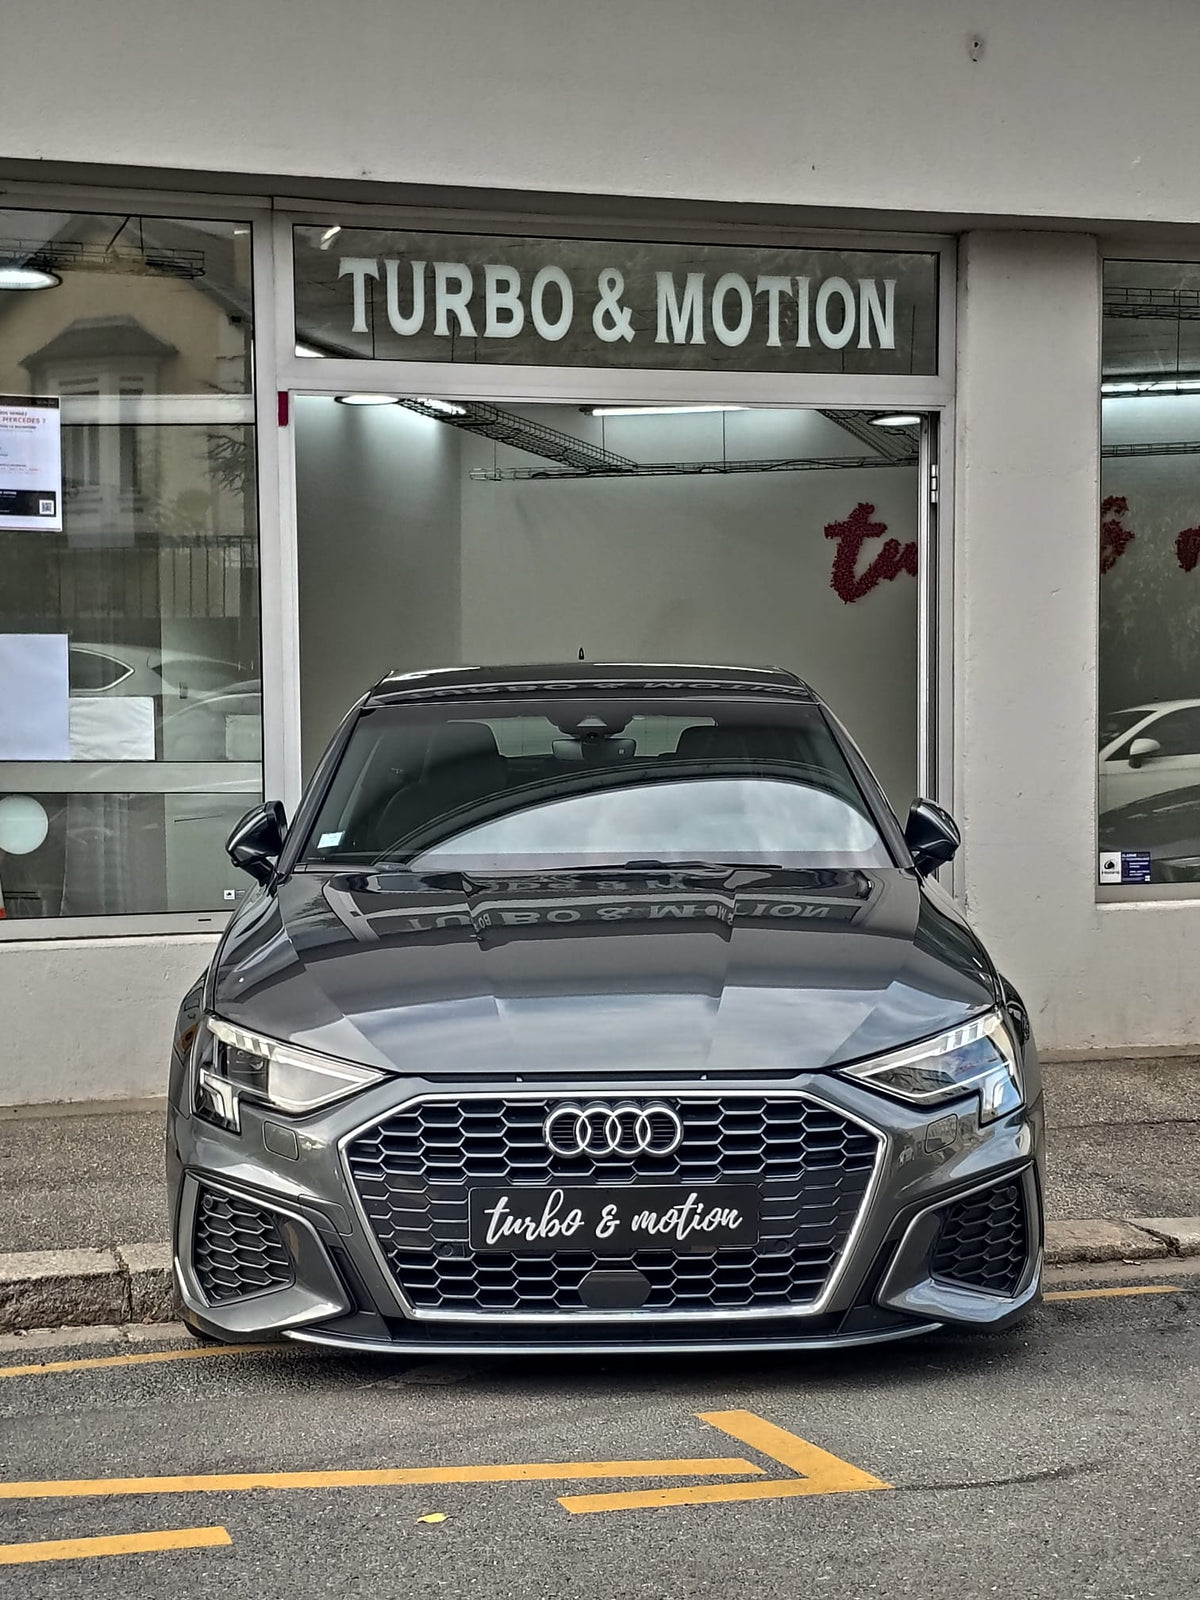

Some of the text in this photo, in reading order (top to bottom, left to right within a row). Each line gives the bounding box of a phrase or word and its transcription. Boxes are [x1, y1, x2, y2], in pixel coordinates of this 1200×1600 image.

[338, 257, 896, 350] TURBO & MOTION
[484, 1189, 743, 1244] turbo & motion
